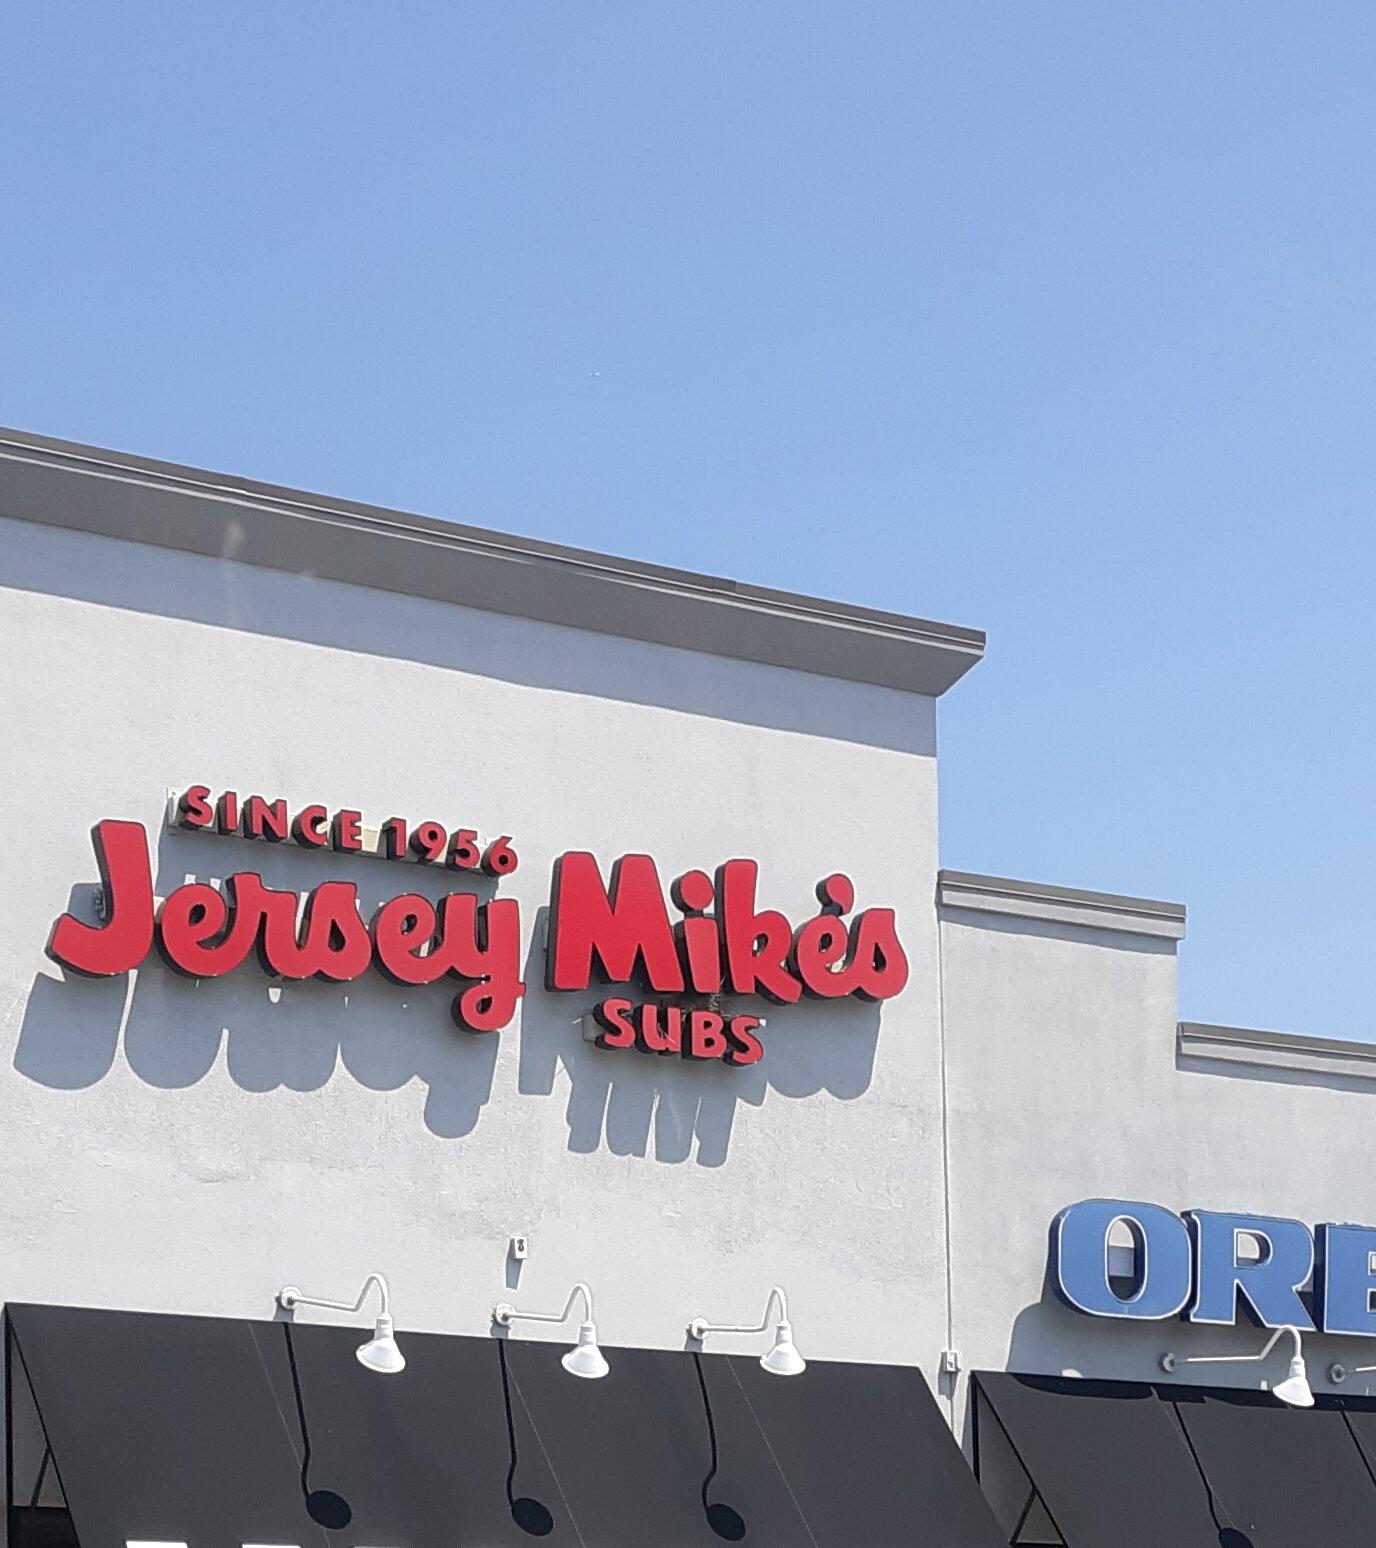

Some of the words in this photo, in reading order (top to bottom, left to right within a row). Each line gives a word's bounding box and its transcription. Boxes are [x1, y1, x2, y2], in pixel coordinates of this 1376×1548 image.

[179, 784, 367, 854] SINCE
[382, 815, 519, 878] 1956
[45, 818, 528, 1034] Jersey
[545, 850, 910, 1006] Mike's
[594, 998, 768, 1067] SUBS
